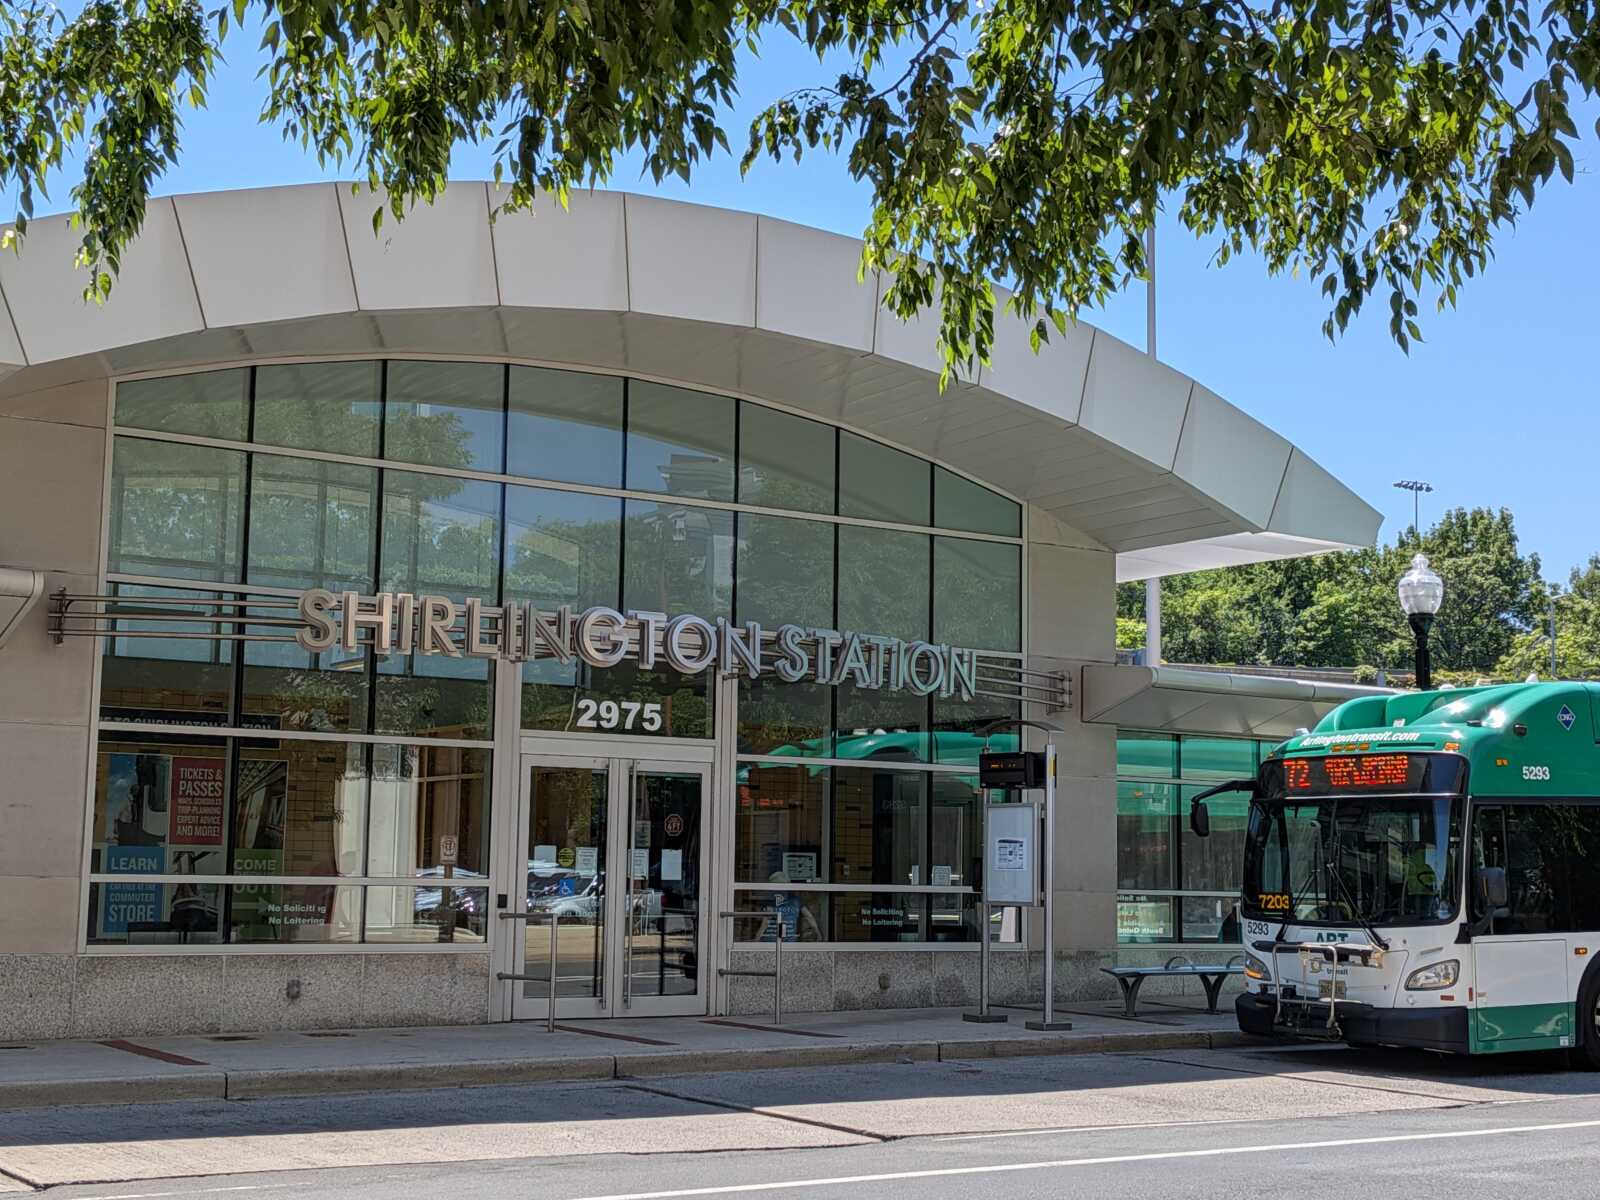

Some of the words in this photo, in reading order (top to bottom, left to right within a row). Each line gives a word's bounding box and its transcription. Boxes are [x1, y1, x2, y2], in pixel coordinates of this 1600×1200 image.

[297, 588, 761, 679] SHIRLINGTON
[774, 624, 977, 701] STATION
[576, 699, 662, 731] 2975
[180, 768, 214, 780] TICKETS
[216, 768, 223, 780] &
[1283, 759, 1311, 789] 72
[1522, 766, 1550, 780] 5293
[179, 781, 222, 797] PASSES
[176, 825, 193, 836] AND
[111, 857, 157, 870] LEARN
[234, 859, 276, 870] COME
[1259, 894, 1290, 909] 7203
[108, 904, 155, 922] STORE
[268, 905, 280, 913] No
[269, 916, 281, 924] No
[1247, 921, 1269, 935] 5293
